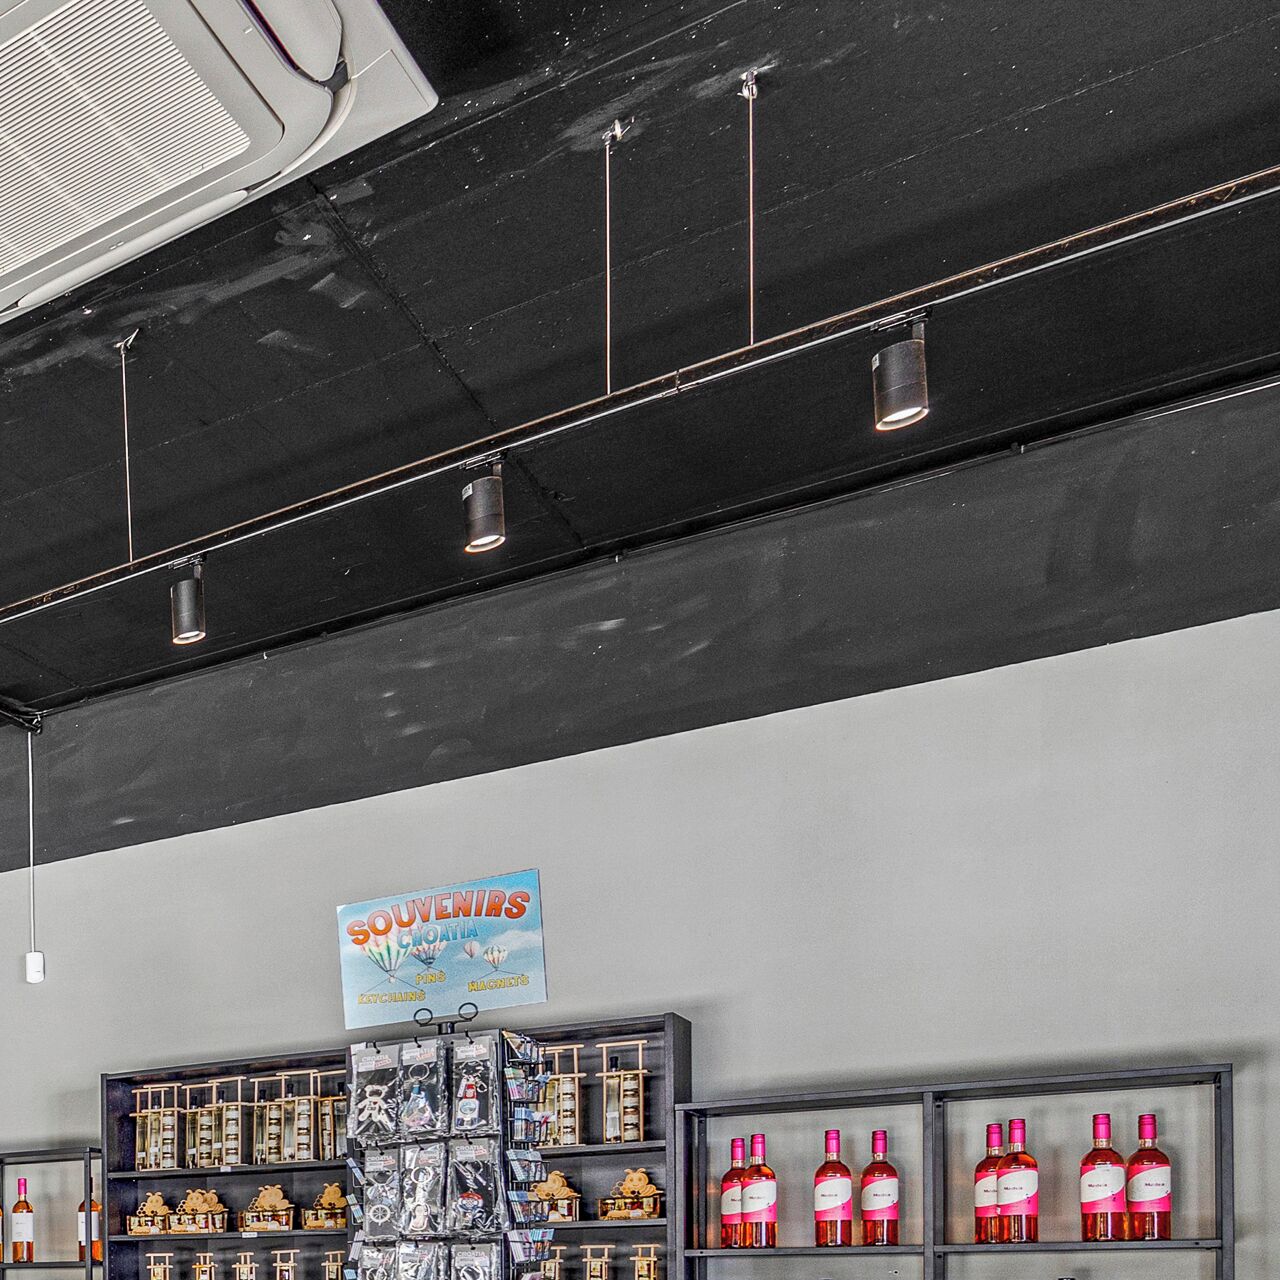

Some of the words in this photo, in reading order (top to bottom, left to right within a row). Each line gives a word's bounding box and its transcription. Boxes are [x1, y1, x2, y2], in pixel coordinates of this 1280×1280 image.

[346, 889, 530, 945] SOUVENIRS
[397, 920, 479, 949] CROATIA
[416, 971, 446, 985] PINS
[467, 975, 530, 992] MAGNETS
[358, 991, 426, 1005] KEYCHAINS
